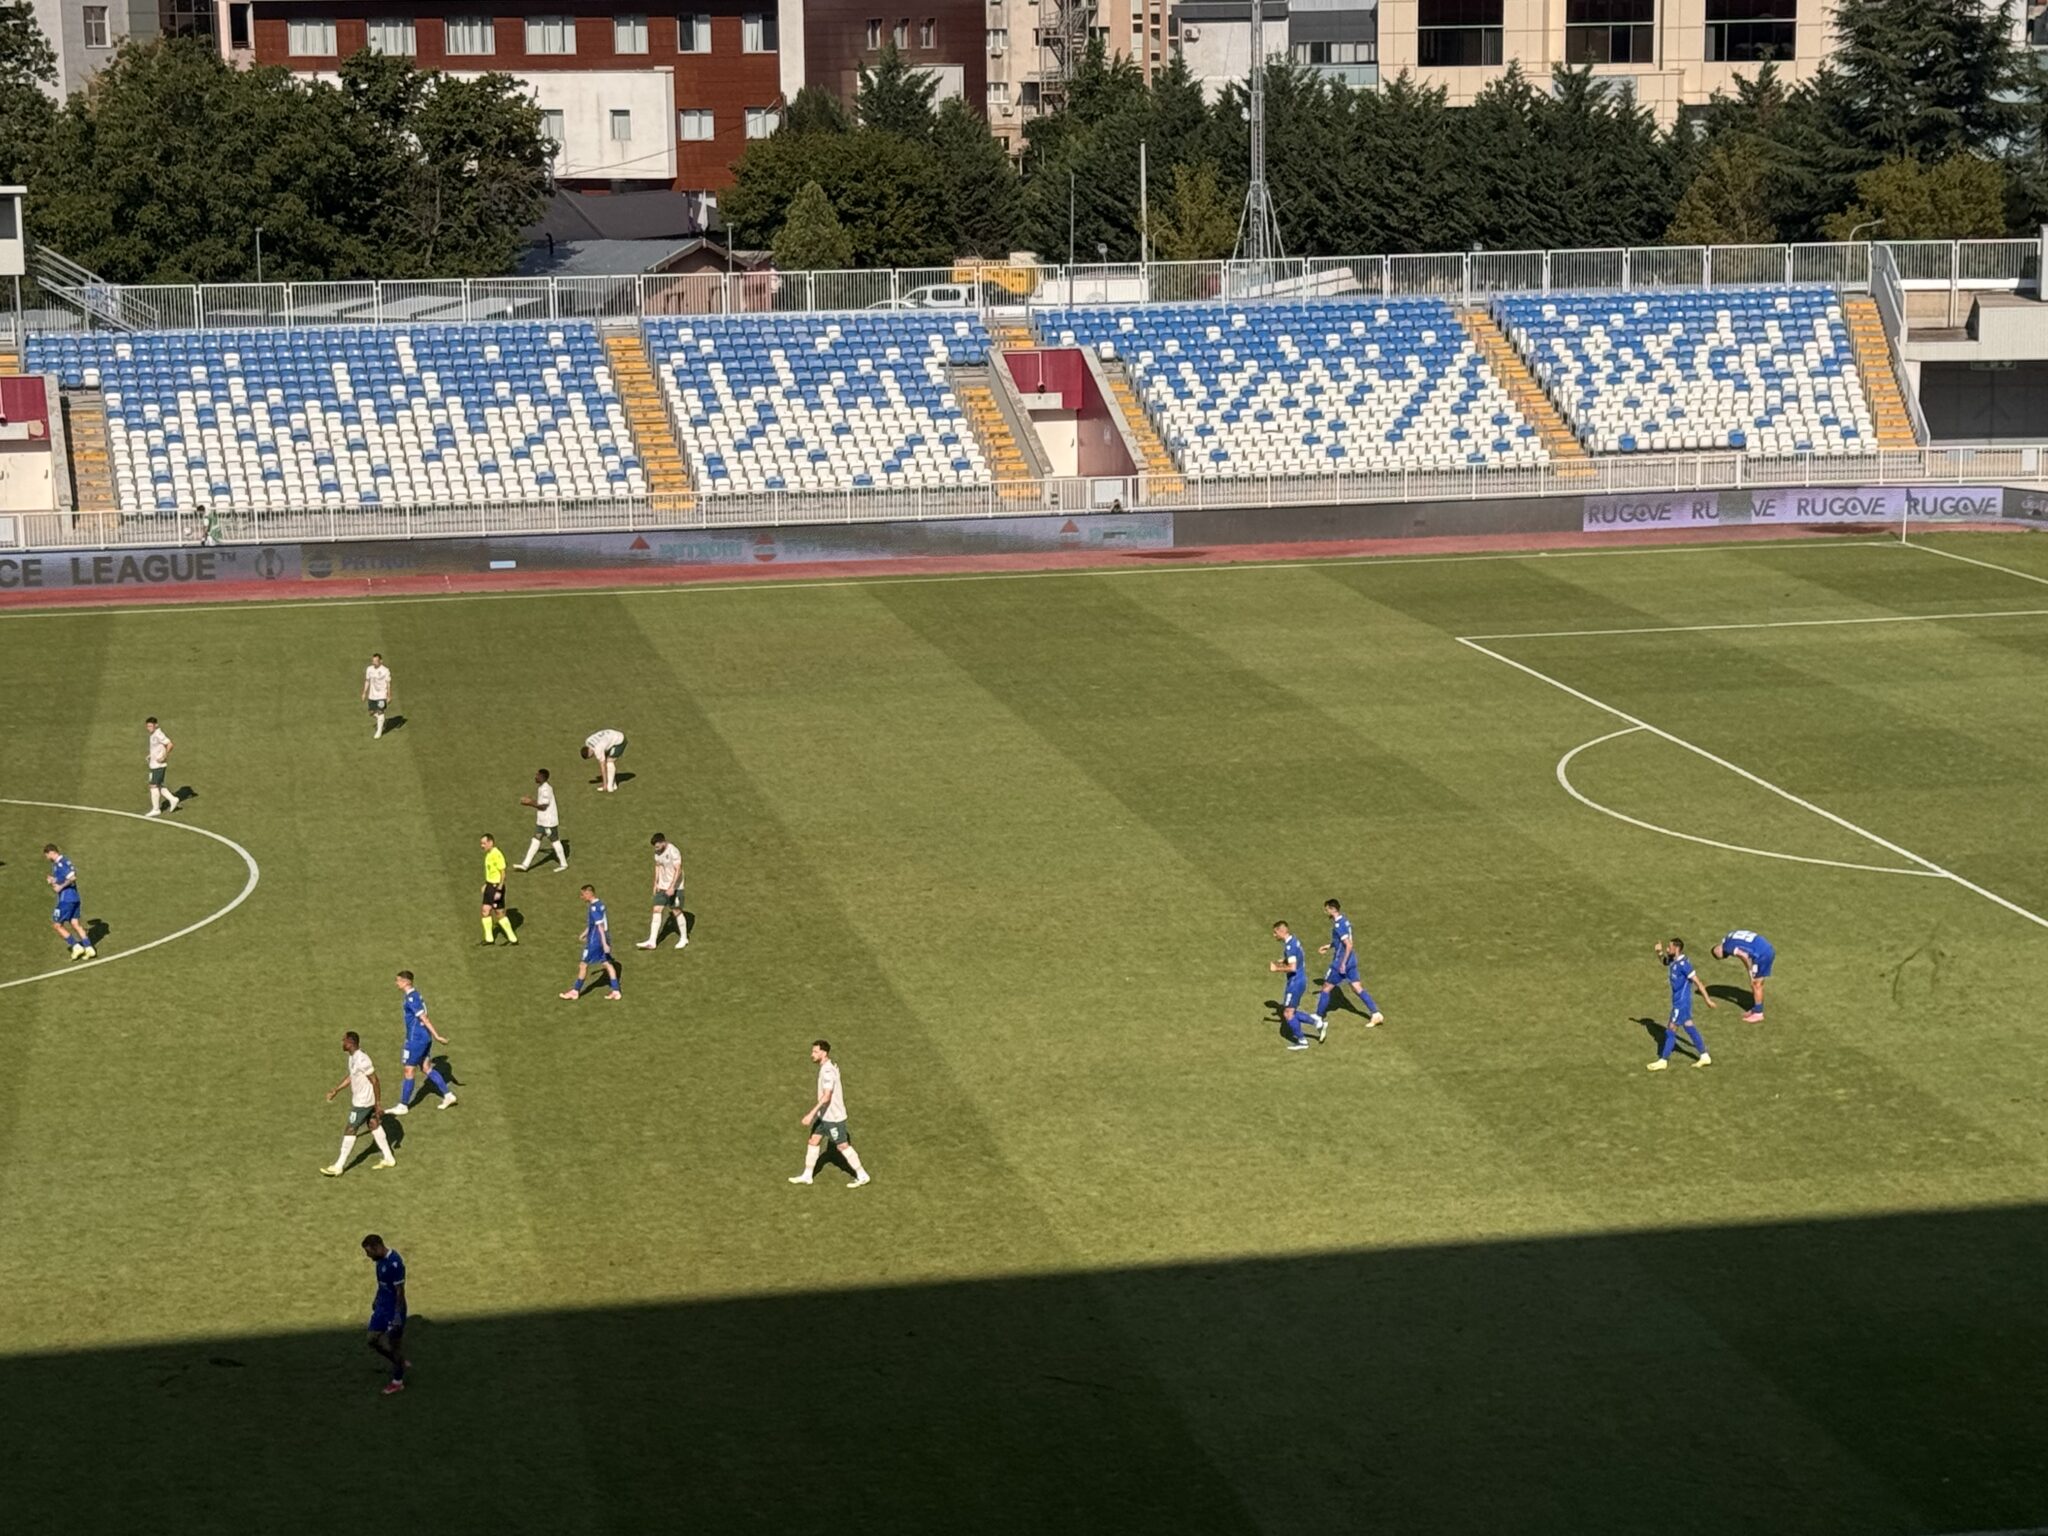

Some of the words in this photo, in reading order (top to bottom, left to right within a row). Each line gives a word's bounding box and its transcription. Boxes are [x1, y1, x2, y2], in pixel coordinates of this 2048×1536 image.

[1589, 502, 1672, 523] RUGOVE
[1797, 496, 1886, 516] RUGOVE
[1907, 496, 1997, 516] RUGOVE
